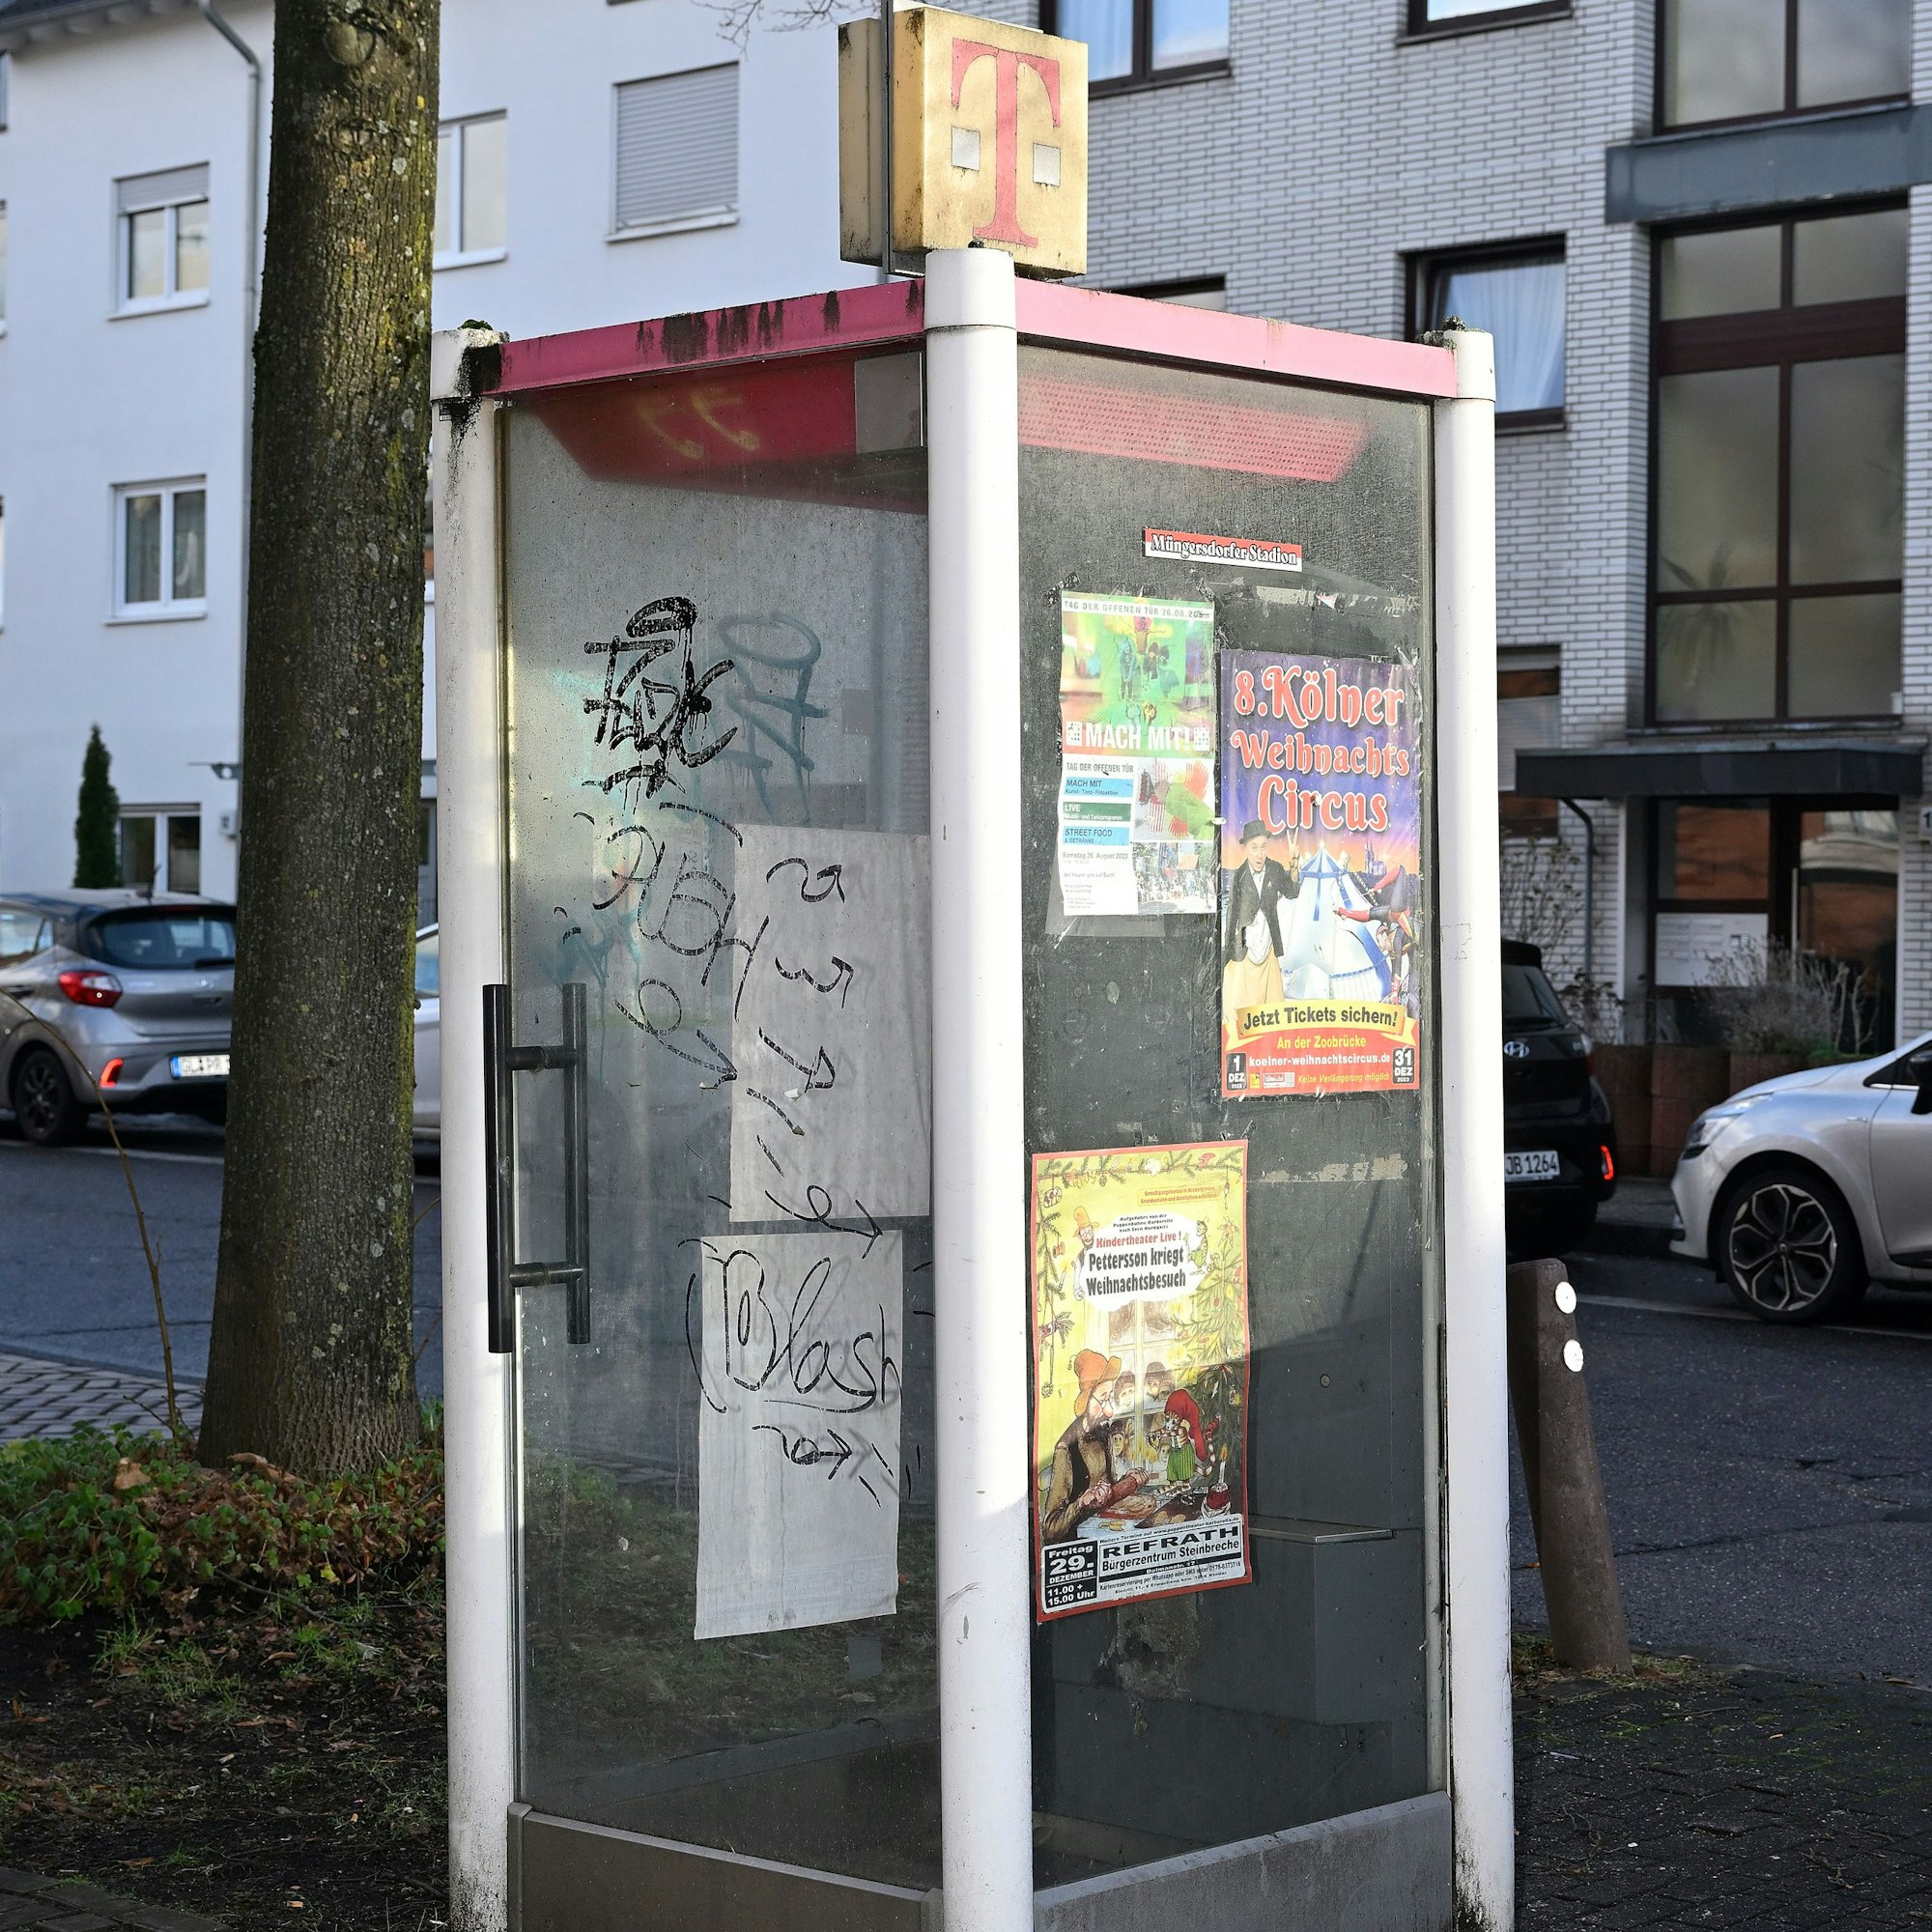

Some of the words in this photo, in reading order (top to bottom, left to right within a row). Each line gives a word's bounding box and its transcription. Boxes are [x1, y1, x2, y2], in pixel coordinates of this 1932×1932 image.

[952, 38, 1061, 248] T
[1151, 533, 1247, 560] Müngersdorfer
[1247, 544, 1297, 565] Stadion
[1065, 600, 1079, 609] TAG
[1082, 602, 1099, 611] DER
[1102, 603, 1141, 614] OFFENEN
[1144, 605, 1159, 615] TÜR
[1086, 723, 1141, 750] MACH
[1149, 726, 1191, 751] MIT!
[1231, 729, 1410, 778] Weihnachts
[1066, 762, 1078, 771] TAG
[1080, 763, 1092, 771] DER
[1093, 764, 1120, 772] OFFENEN
[1122, 763, 1134, 773] TÜR
[1258, 774, 1388, 836] Circus
[1244, 1009, 1280, 1030] Jetzt
[1284, 1006, 1336, 1024] Tickets
[1341, 1006, 1398, 1028] sichern!
[1277, 1036, 1291, 1049] An
[1294, 1036, 1311, 1049] der
[1314, 1035, 1367, 1049] Zoobrücke
[1233, 1055, 1240, 1072] 1
[1249, 1052, 1390, 1067] koelner-weihnachtscircus.de
[1395, 1049, 1412, 1066] 31
[1228, 1072, 1245, 1082] DEZ
[1320, 1074, 1363, 1083] Verlängerung
[1365, 1072, 1390, 1082] möglich
[1395, 1067, 1413, 1076] DEZ
[1525, 1154, 1557, 1173] 1264
[1096, 1235, 1158, 1248] Kindertheater
[1160, 1232, 1177, 1242] Live
[1089, 1251, 1148, 1272] Pettersson
[1151, 1246, 1184, 1267] kriegt
[1086, 1269, 1186, 1296] Weihnachtsbesuch
[1103, 1527, 1238, 1558] REFRATH
[1049, 1546, 1093, 1558] Freitag
[1103, 1550, 1176, 1571] Bürgerzentrum
[1179, 1539, 1239, 1557] Steinbreche
[1050, 1555, 1094, 1575] 29.
[1050, 1570, 1094, 1584] DEZEMBER
[1100, 1579, 1143, 1590] Kartenreservierung
[1048, 1585, 1074, 1596] 11.00
[1048, 1594, 1074, 1605] 15.00
[1077, 1591, 1095, 1599] Uhr
